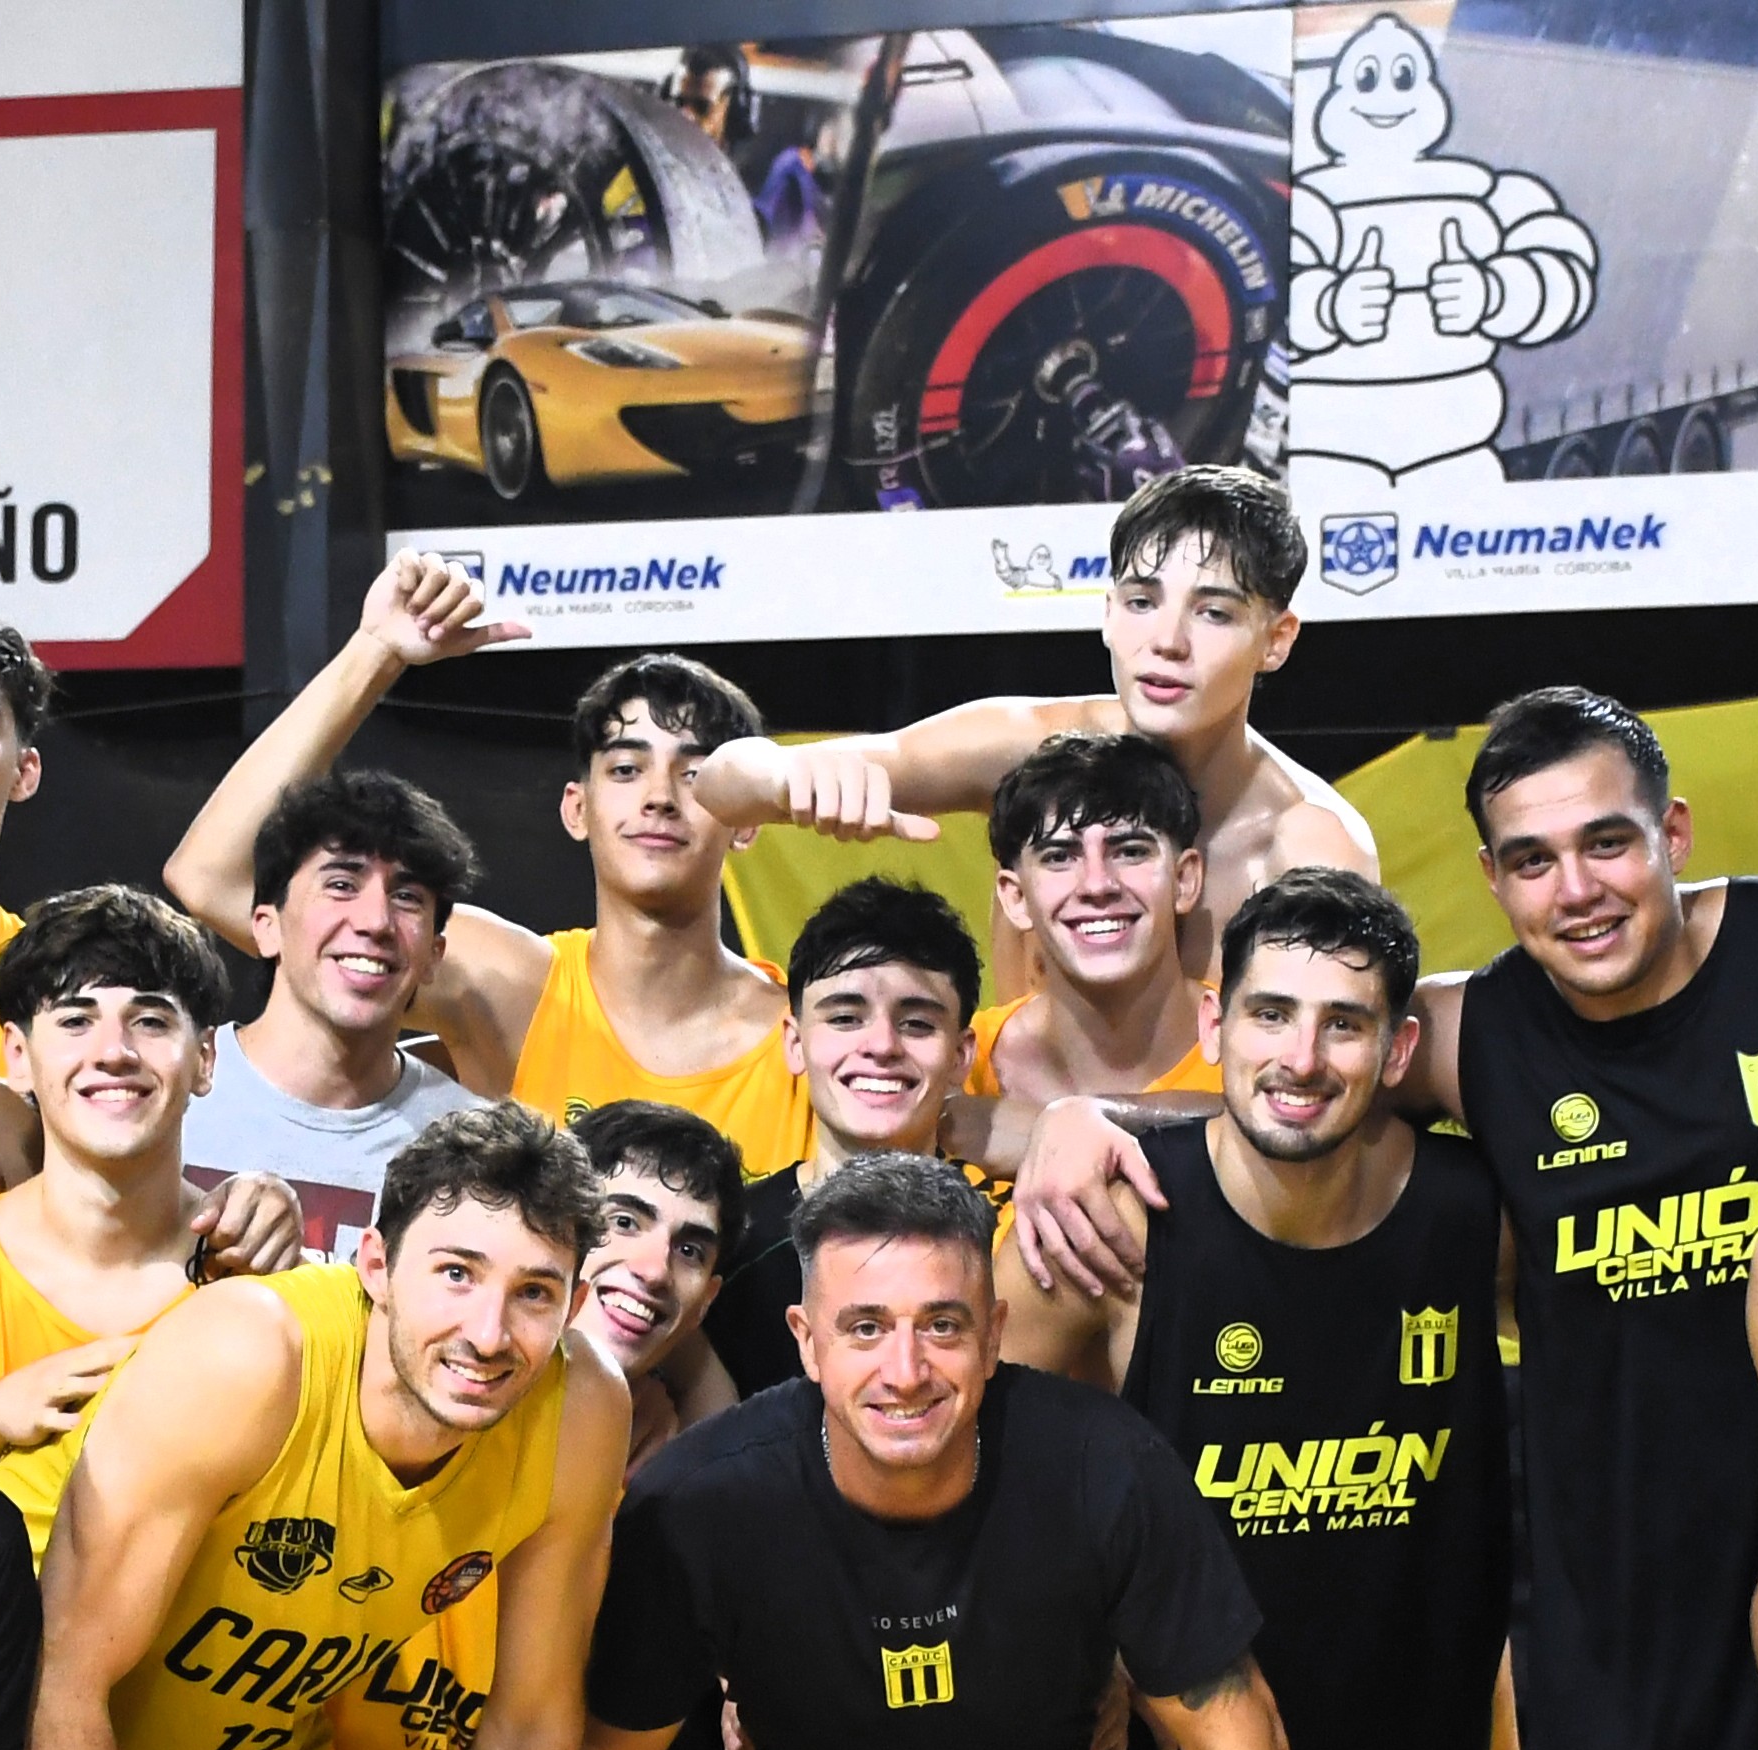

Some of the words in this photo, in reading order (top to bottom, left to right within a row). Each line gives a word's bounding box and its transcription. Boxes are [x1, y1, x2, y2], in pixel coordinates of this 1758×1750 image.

[1134, 183, 1269, 292] MICHELIN
[1412, 513, 1667, 559] NeumaNek
[496, 556, 727, 597] NeumaNek
[1537, 1141, 1628, 1171] LENING
[1607, 1275, 1690, 1303] VILLA
[1193, 1377, 1285, 1394] LENING
[1194, 1420, 1452, 1499] UNIÓN
[1230, 1480, 1417, 1519] CENTRAL
[1235, 1517, 1311, 1538] VILLA
[1326, 1509, 1410, 1532] MARIA
[900, 1604, 958, 1630] SEVEN
